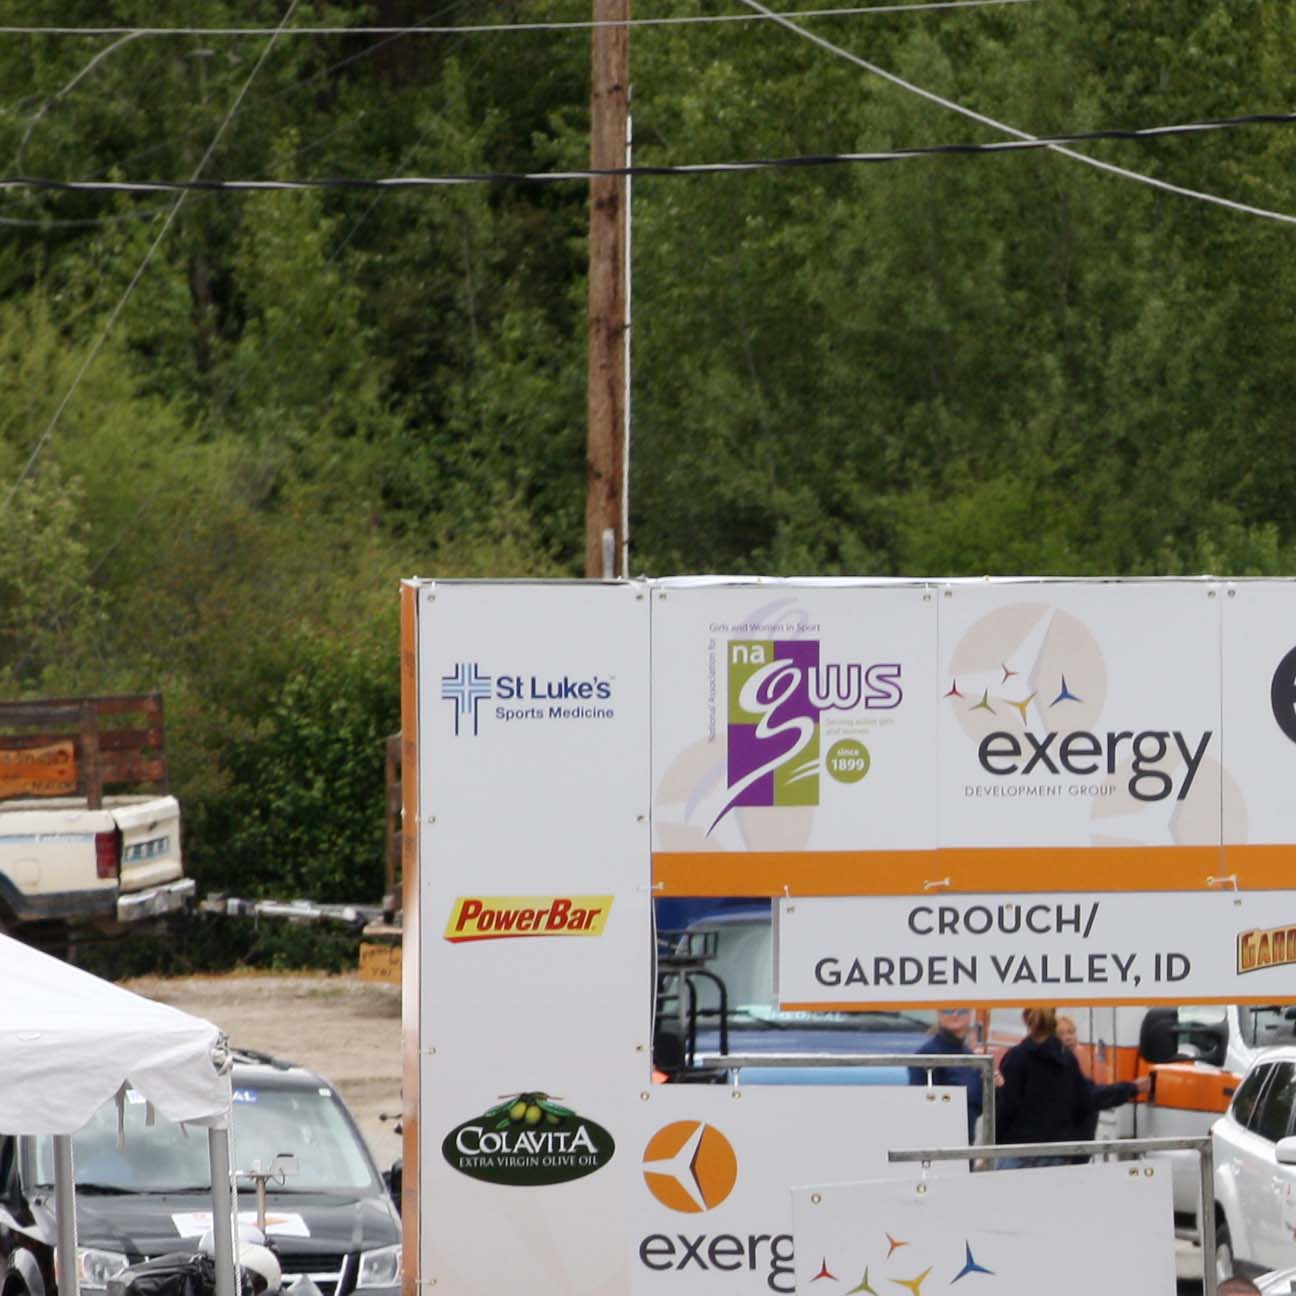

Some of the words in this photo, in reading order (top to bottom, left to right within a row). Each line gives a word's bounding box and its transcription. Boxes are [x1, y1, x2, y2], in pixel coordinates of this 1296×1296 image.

[496, 676, 524, 700] St
[495, 706, 544, 722] Sports
[548, 706, 615, 720] Medicine
[831, 758, 865, 771] 1899
[977, 730, 1214, 802] exergy
[964, 784, 1063, 798] DEVELOPMENT
[1068, 783, 1117, 797] GROUP
[453, 900, 603, 933] PowerBar
[907, 902, 1100, 938] CROUCH/
[813, 955, 979, 987] GARDEN
[992, 952, 1142, 989] VALLEY,
[1154, 952, 1192, 983] ID
[455, 1124, 599, 1156] COLAVITA
[459, 1156, 494, 1168] EXTRA
[497, 1156, 540, 1168] VIRGIN
[542, 1156, 575, 1167] OLIVE
[578, 1155, 599, 1166] OIL
